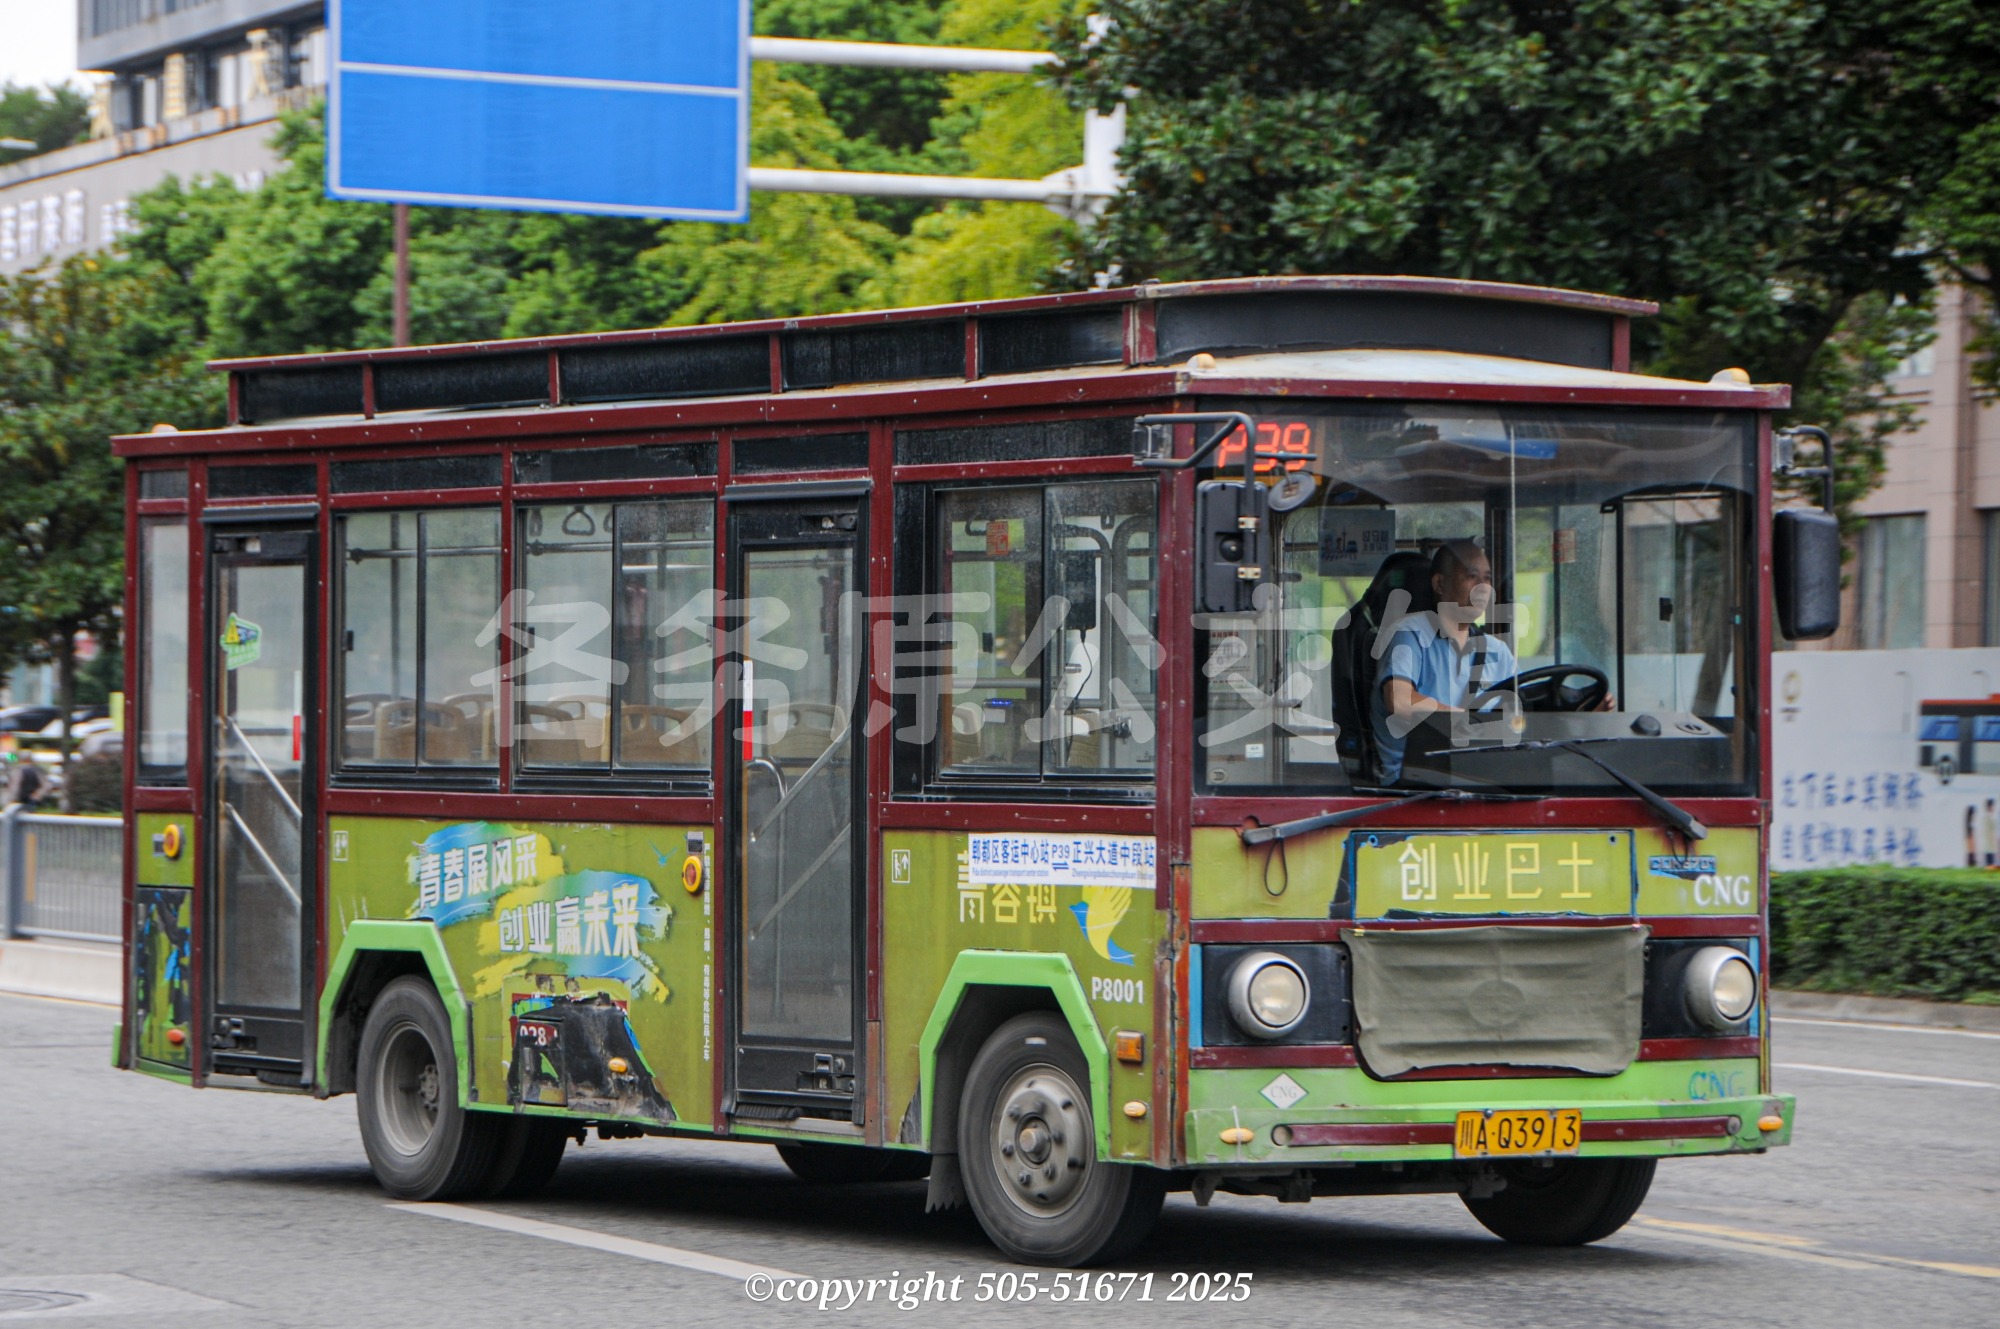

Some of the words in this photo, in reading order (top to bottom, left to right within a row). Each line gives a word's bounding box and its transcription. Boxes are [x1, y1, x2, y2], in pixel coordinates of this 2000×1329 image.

[1217, 421, 1311, 472] P39
[971, 838, 1050, 864] 郫都区客运中心站
[1052, 844, 1070, 859] P39
[1072, 840, 1155, 867] 正兴大道中段站
[420, 833, 538, 910] 青春展风采
[1398, 841, 1594, 900] 创业巴士
[1694, 874, 1751, 907] CNG
[499, 882, 642, 959] 创业赢未来
[1091, 976, 1144, 1004] P8001
[1270, 1085, 1297, 1099] CNG
[1688, 1070, 1745, 1100] CNG
[1459, 1115, 1577, 1150] 川A·Q3913
